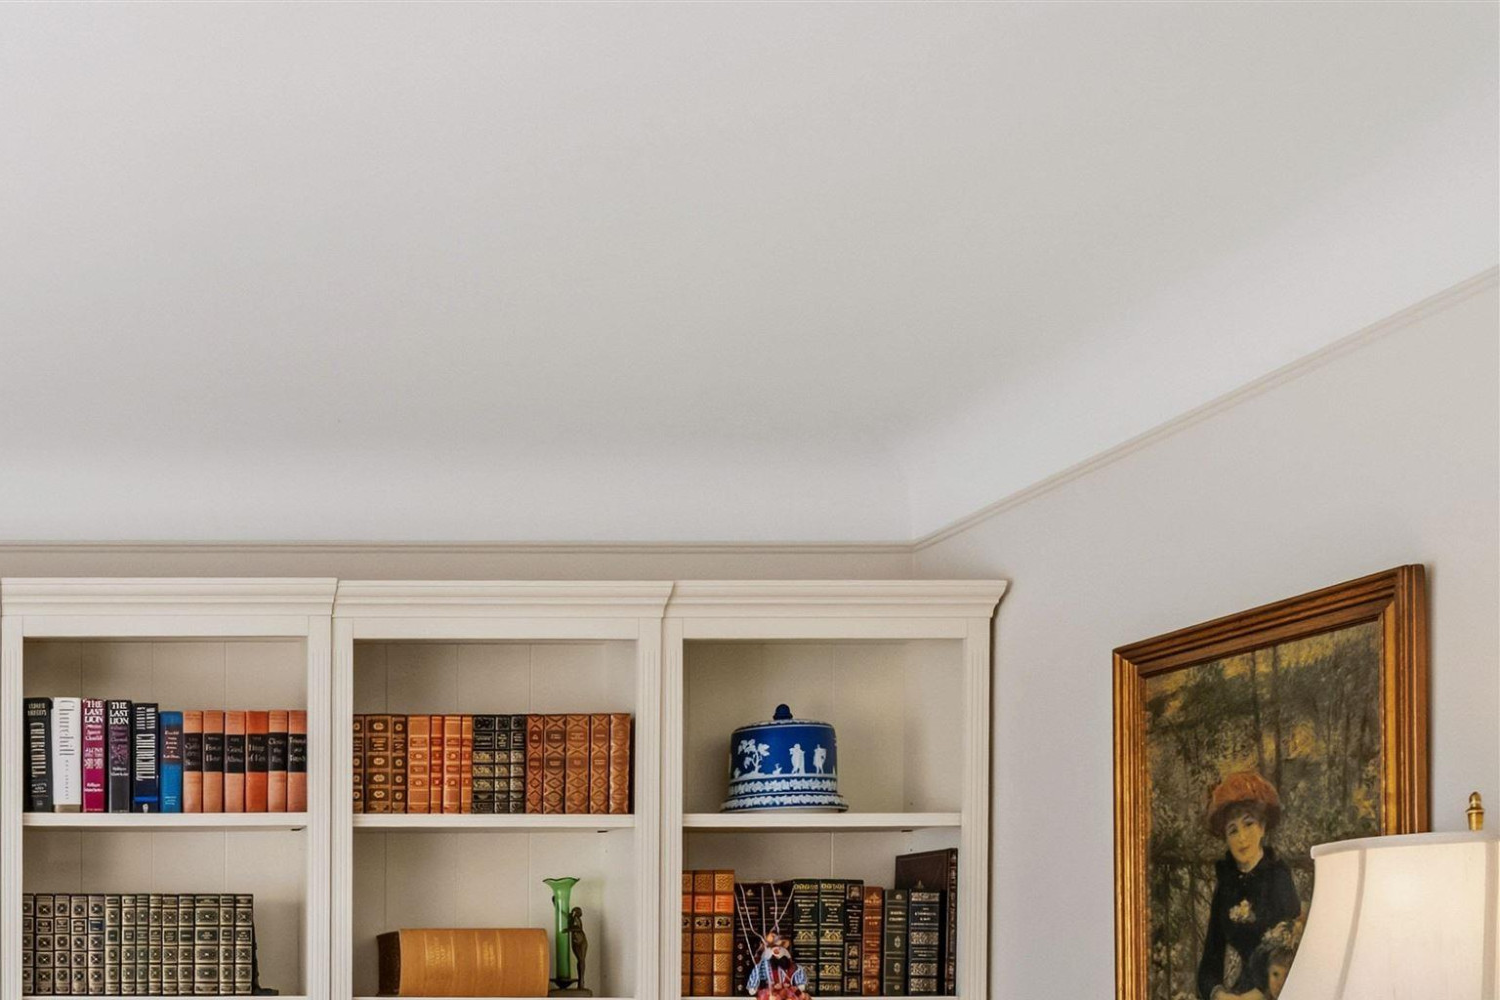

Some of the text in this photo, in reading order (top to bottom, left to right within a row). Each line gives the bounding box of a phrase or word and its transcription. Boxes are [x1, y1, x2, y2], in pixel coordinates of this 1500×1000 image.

[59, 700, 75, 756] Churchill
[84, 708, 104, 716] LAST
[87, 700, 103, 708] THE
[30, 722, 46, 778] CHURCHILL
[136, 733, 156, 781] CHURCHILL
